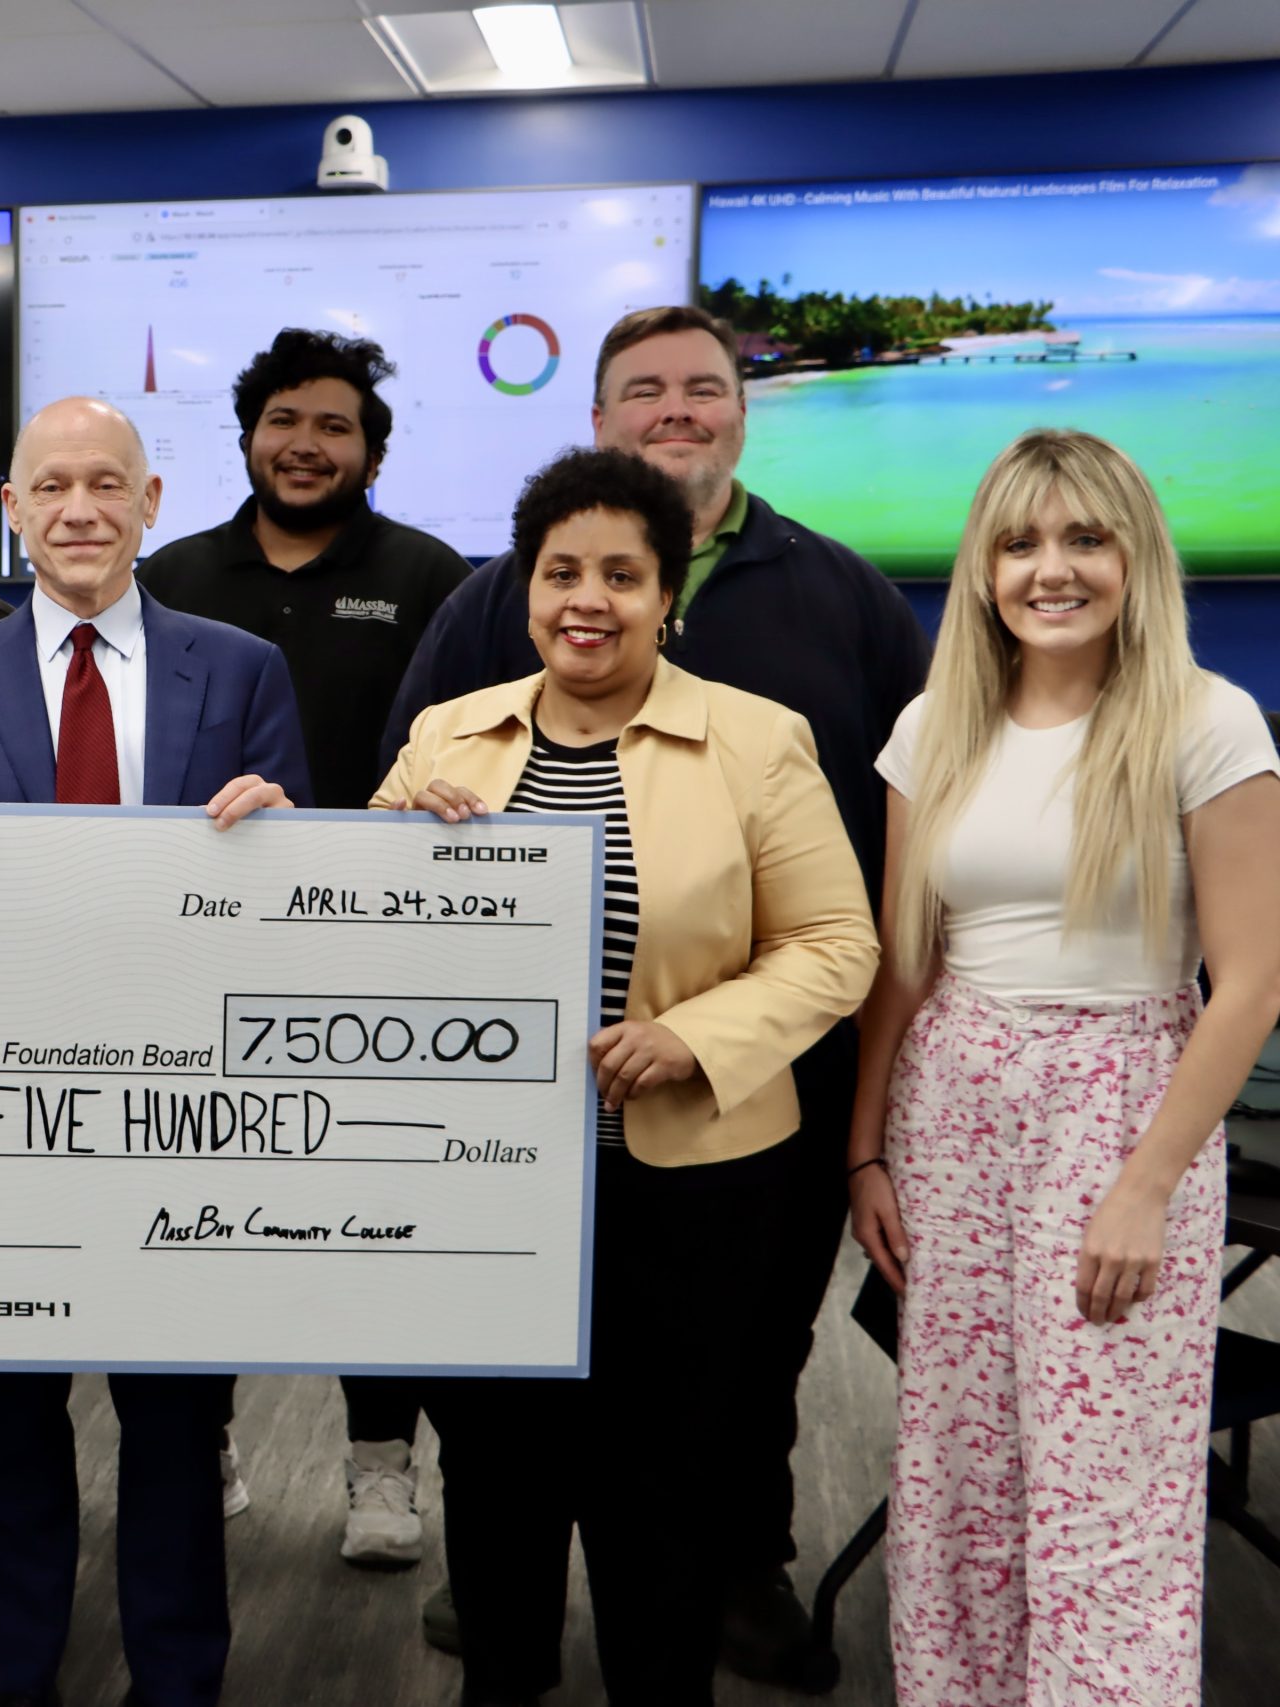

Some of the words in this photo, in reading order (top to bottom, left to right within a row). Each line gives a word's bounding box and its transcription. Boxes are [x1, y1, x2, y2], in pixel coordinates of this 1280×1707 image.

[804, 192, 852, 206] Calming
[854, 190, 889, 203] Music
[892, 189, 919, 201] With
[922, 186, 975, 200] Beautiful
[977, 185, 1020, 198] Natural
[1023, 182, 1096, 197] Landscapes
[1099, 180, 1125, 192] Film
[1129, 178, 1149, 191] For
[1152, 176, 1217, 190] Relaxation
[433, 846, 548, 862] 200012
[180, 893, 242, 918] Date
[287, 886, 368, 917] APRIL
[239, 1013, 519, 1064] 7,500.00
[2, 1042, 134, 1067] Foundation
[141, 1044, 214, 1068] Board
[124, 1089, 330, 1155] HUNDRED
[442, 1138, 538, 1164] Dollars
